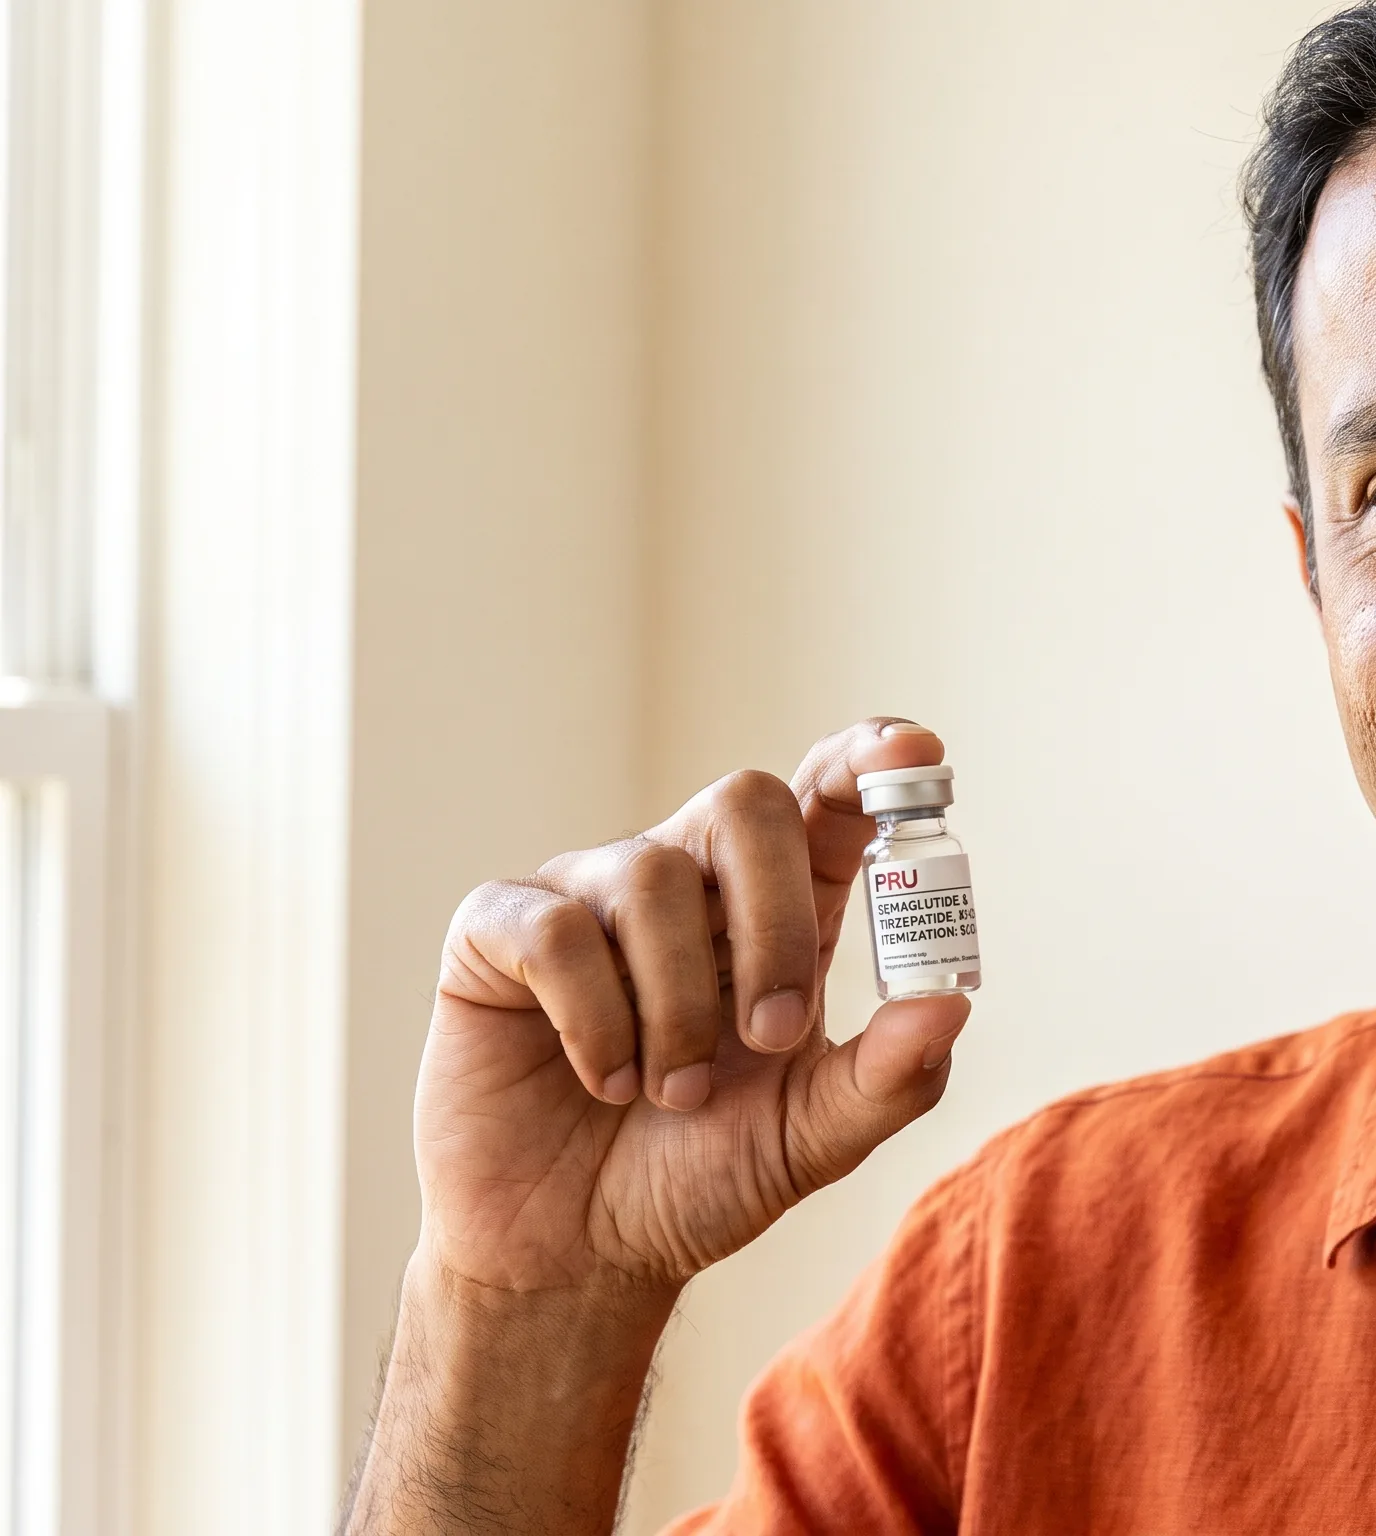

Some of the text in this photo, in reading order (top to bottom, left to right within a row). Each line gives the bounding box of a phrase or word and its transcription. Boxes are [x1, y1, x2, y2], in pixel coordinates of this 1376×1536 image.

[875, 869, 918, 892] PRU
[878, 895, 960, 916] SEMAGLUTIDE
[880, 911, 957, 930] TIRZEPATIDE,
[881, 926, 958, 946] ITEMIZATION:
